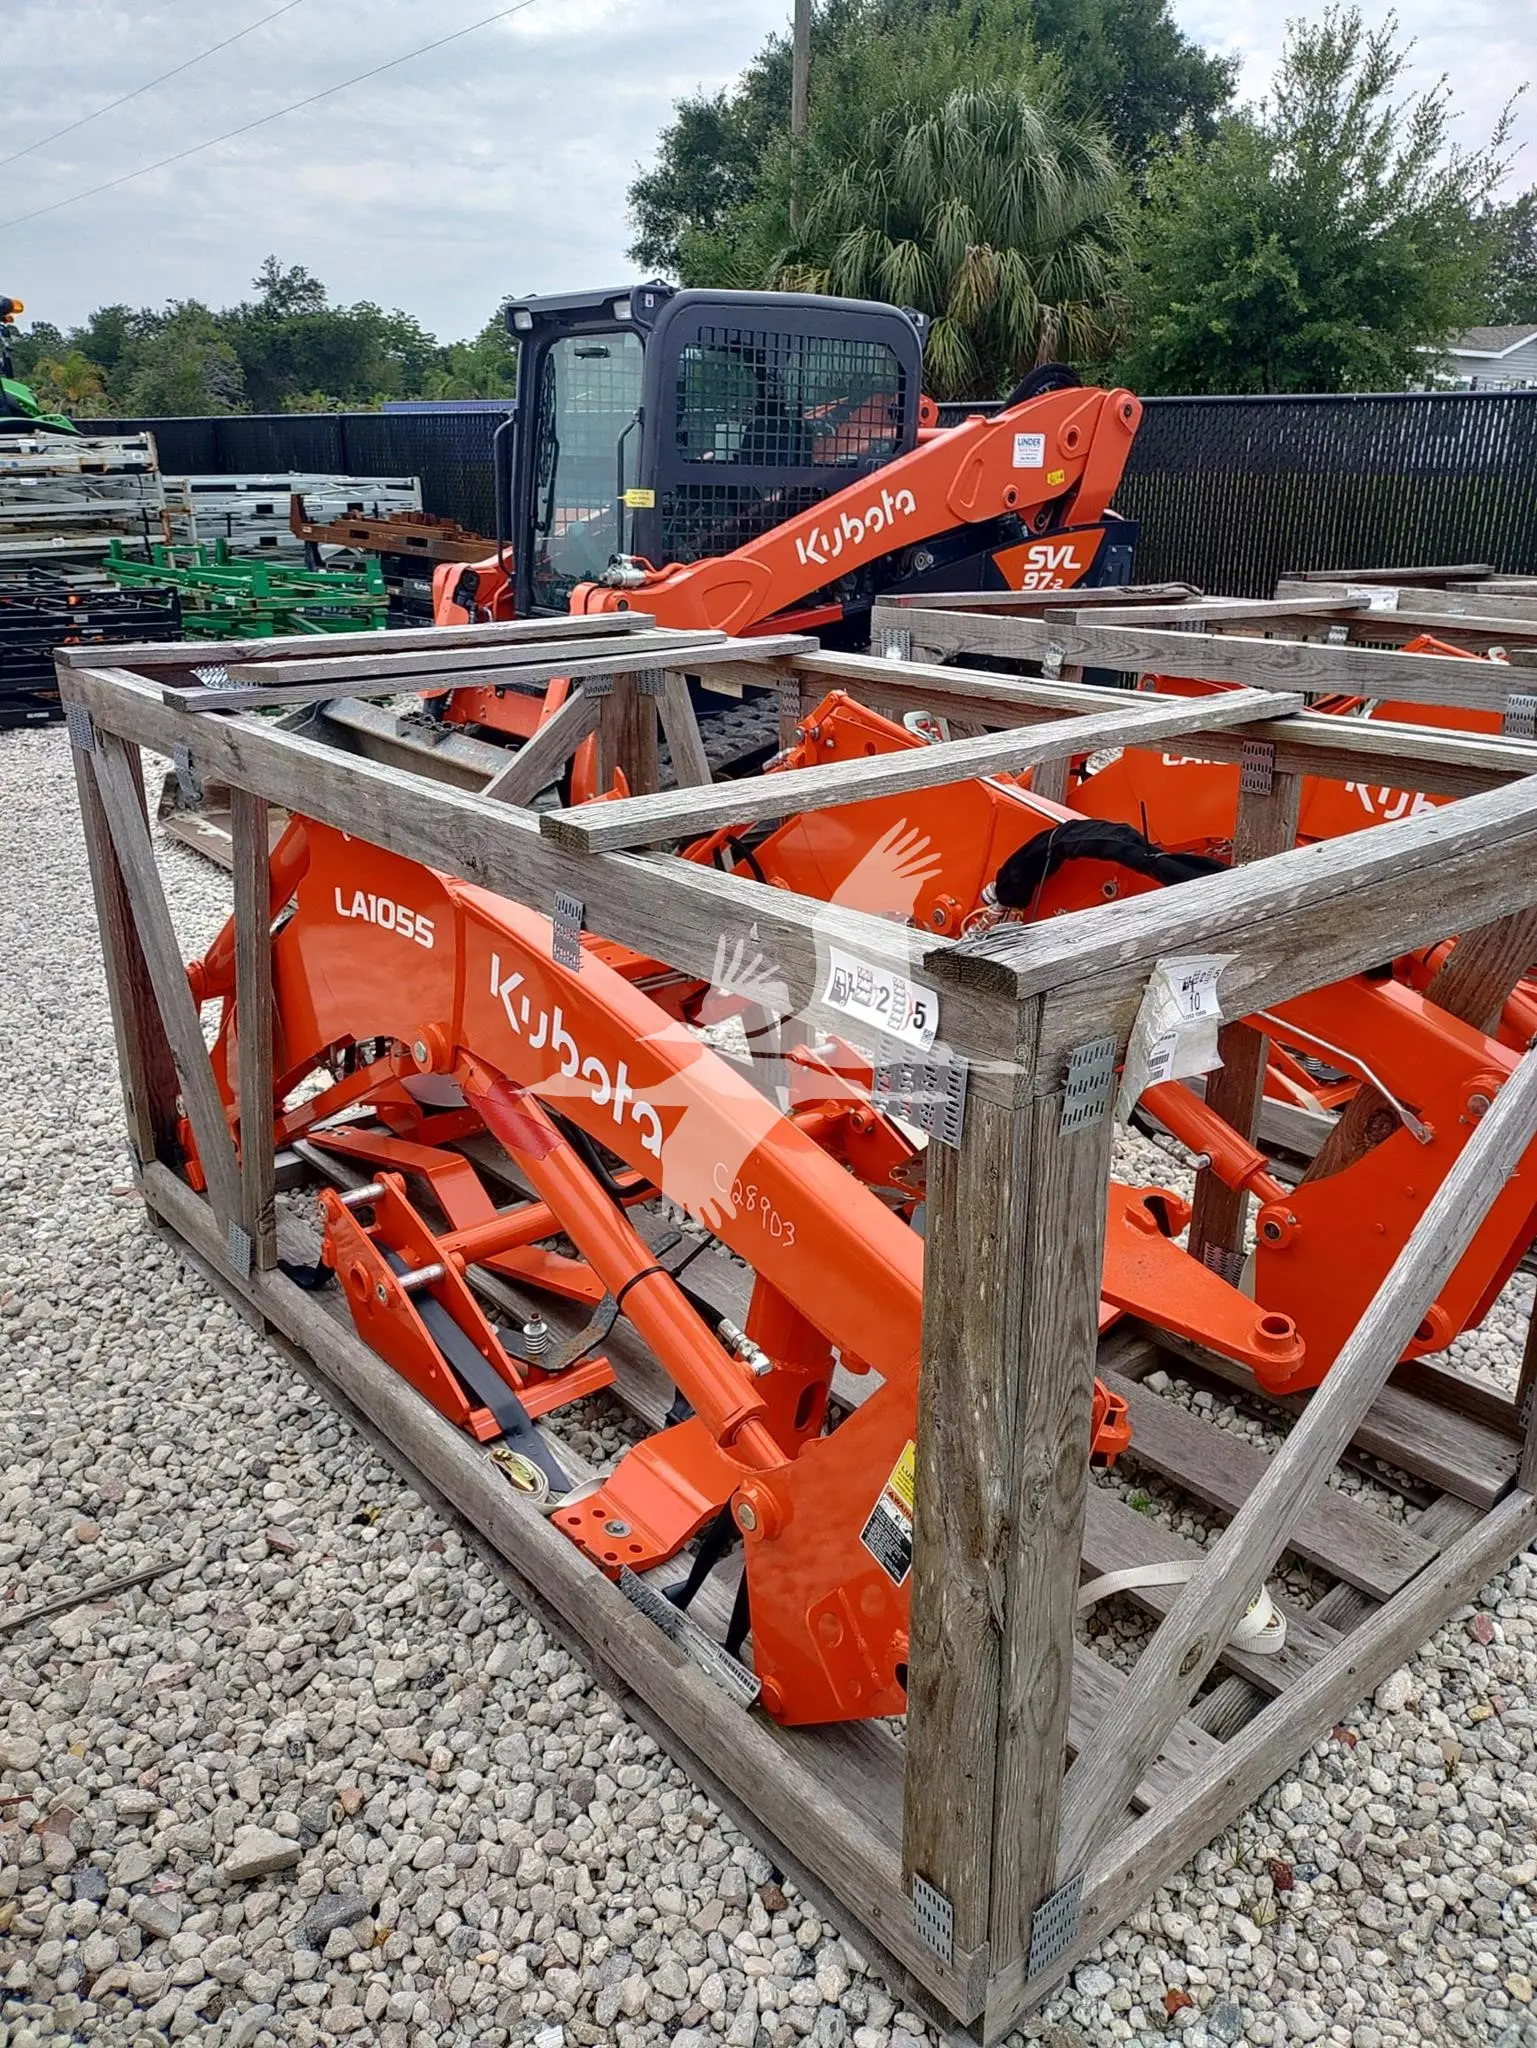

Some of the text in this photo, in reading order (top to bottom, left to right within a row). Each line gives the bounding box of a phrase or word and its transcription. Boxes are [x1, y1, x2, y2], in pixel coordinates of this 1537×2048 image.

[795, 488, 917, 565] Kubota
[1023, 545, 1082, 570] SVL
[334, 887, 435, 949] LA1055
[876, 986, 928, 1029] 2 5
[1189, 992, 1201, 1012] 10
[490, 952, 663, 1160] Kubota
